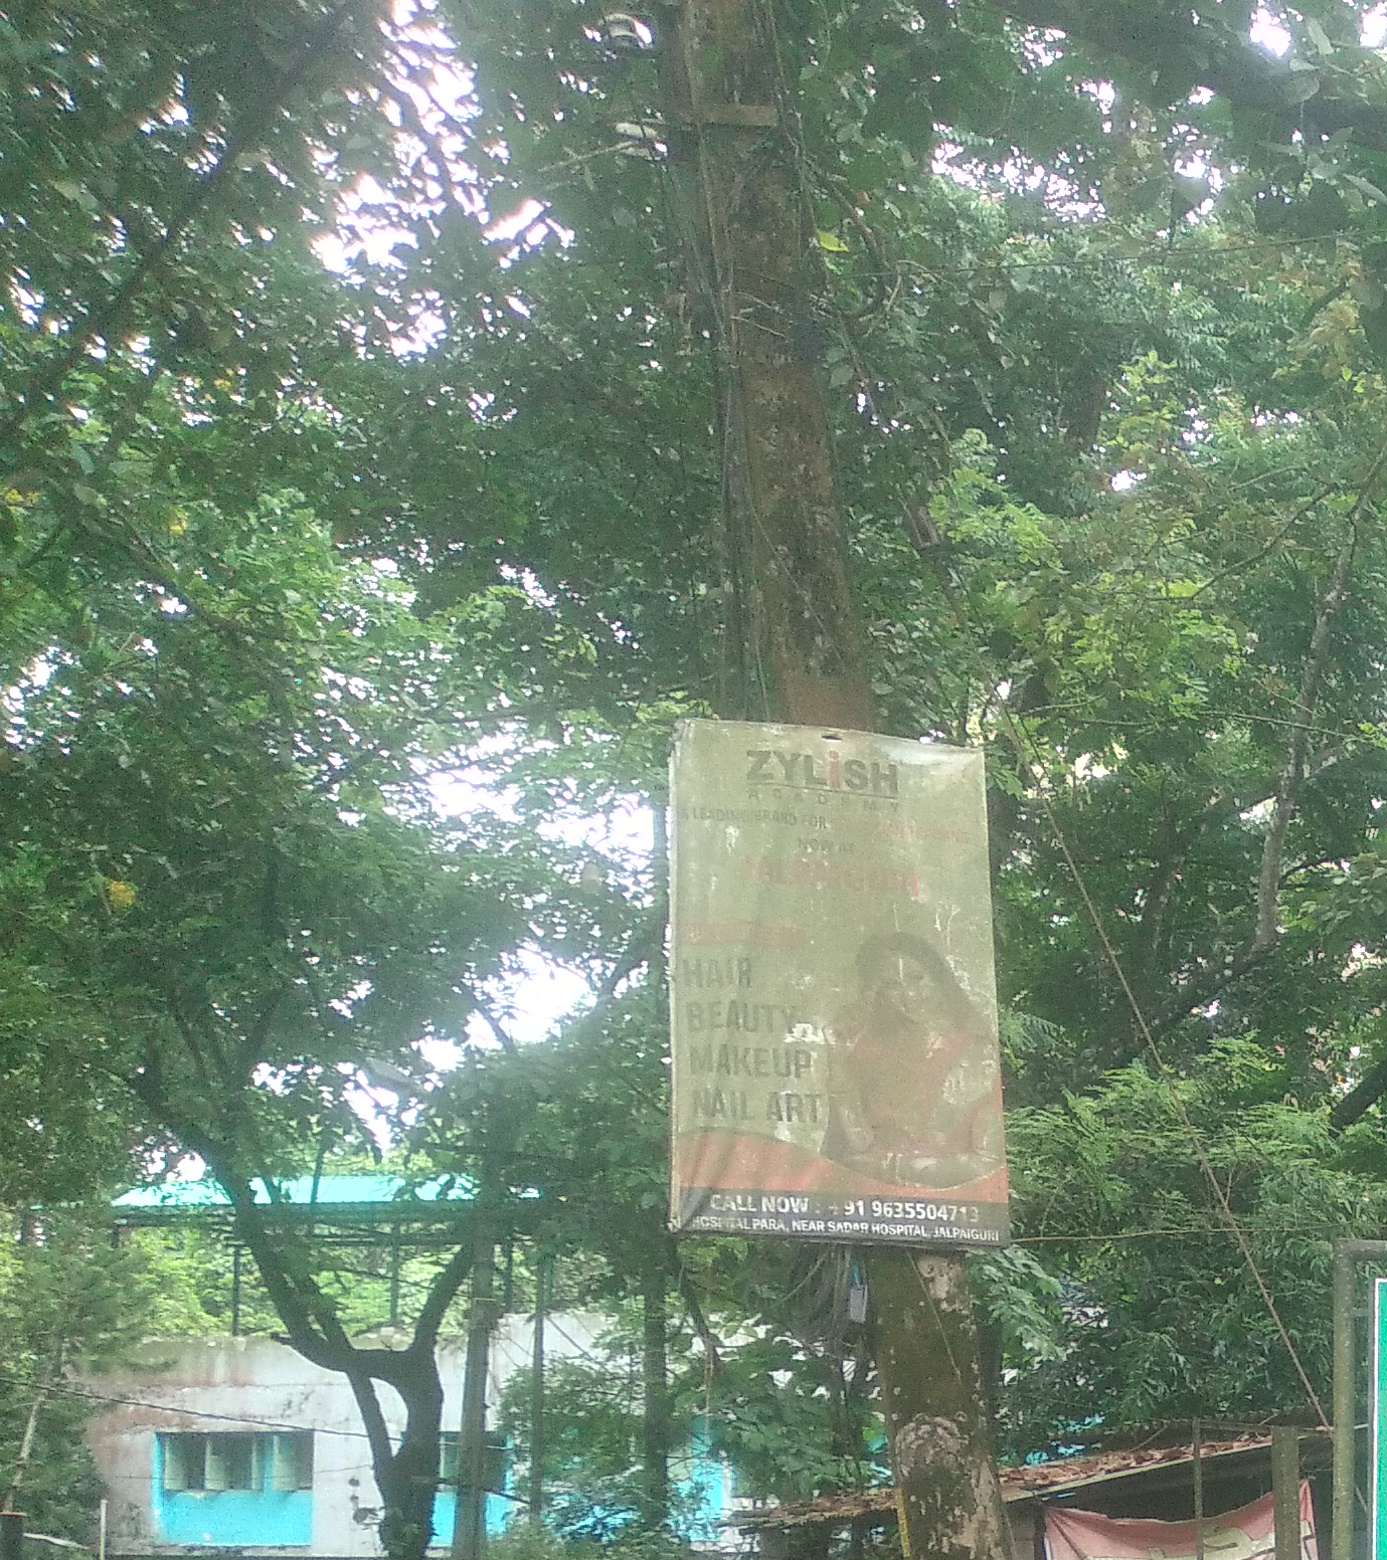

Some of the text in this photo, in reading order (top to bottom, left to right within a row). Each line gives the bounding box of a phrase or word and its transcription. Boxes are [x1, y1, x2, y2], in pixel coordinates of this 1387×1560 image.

[682, 958, 751, 988] HAIR
[686, 1000, 796, 1034] BEAUTY
[688, 1043, 812, 1079] MAKEUP
[691, 1088, 823, 1123] NAIL ART
[709, 1193, 757, 1213] CALL
[761, 1195, 810, 1214] NOW
[843, 1199, 865, 1217] 91
[752, 1217, 790, 1233] PARA,
[791, 1219, 826, 1233] NEAR
[933, 1223, 1000, 1243] JALPAIGURI
